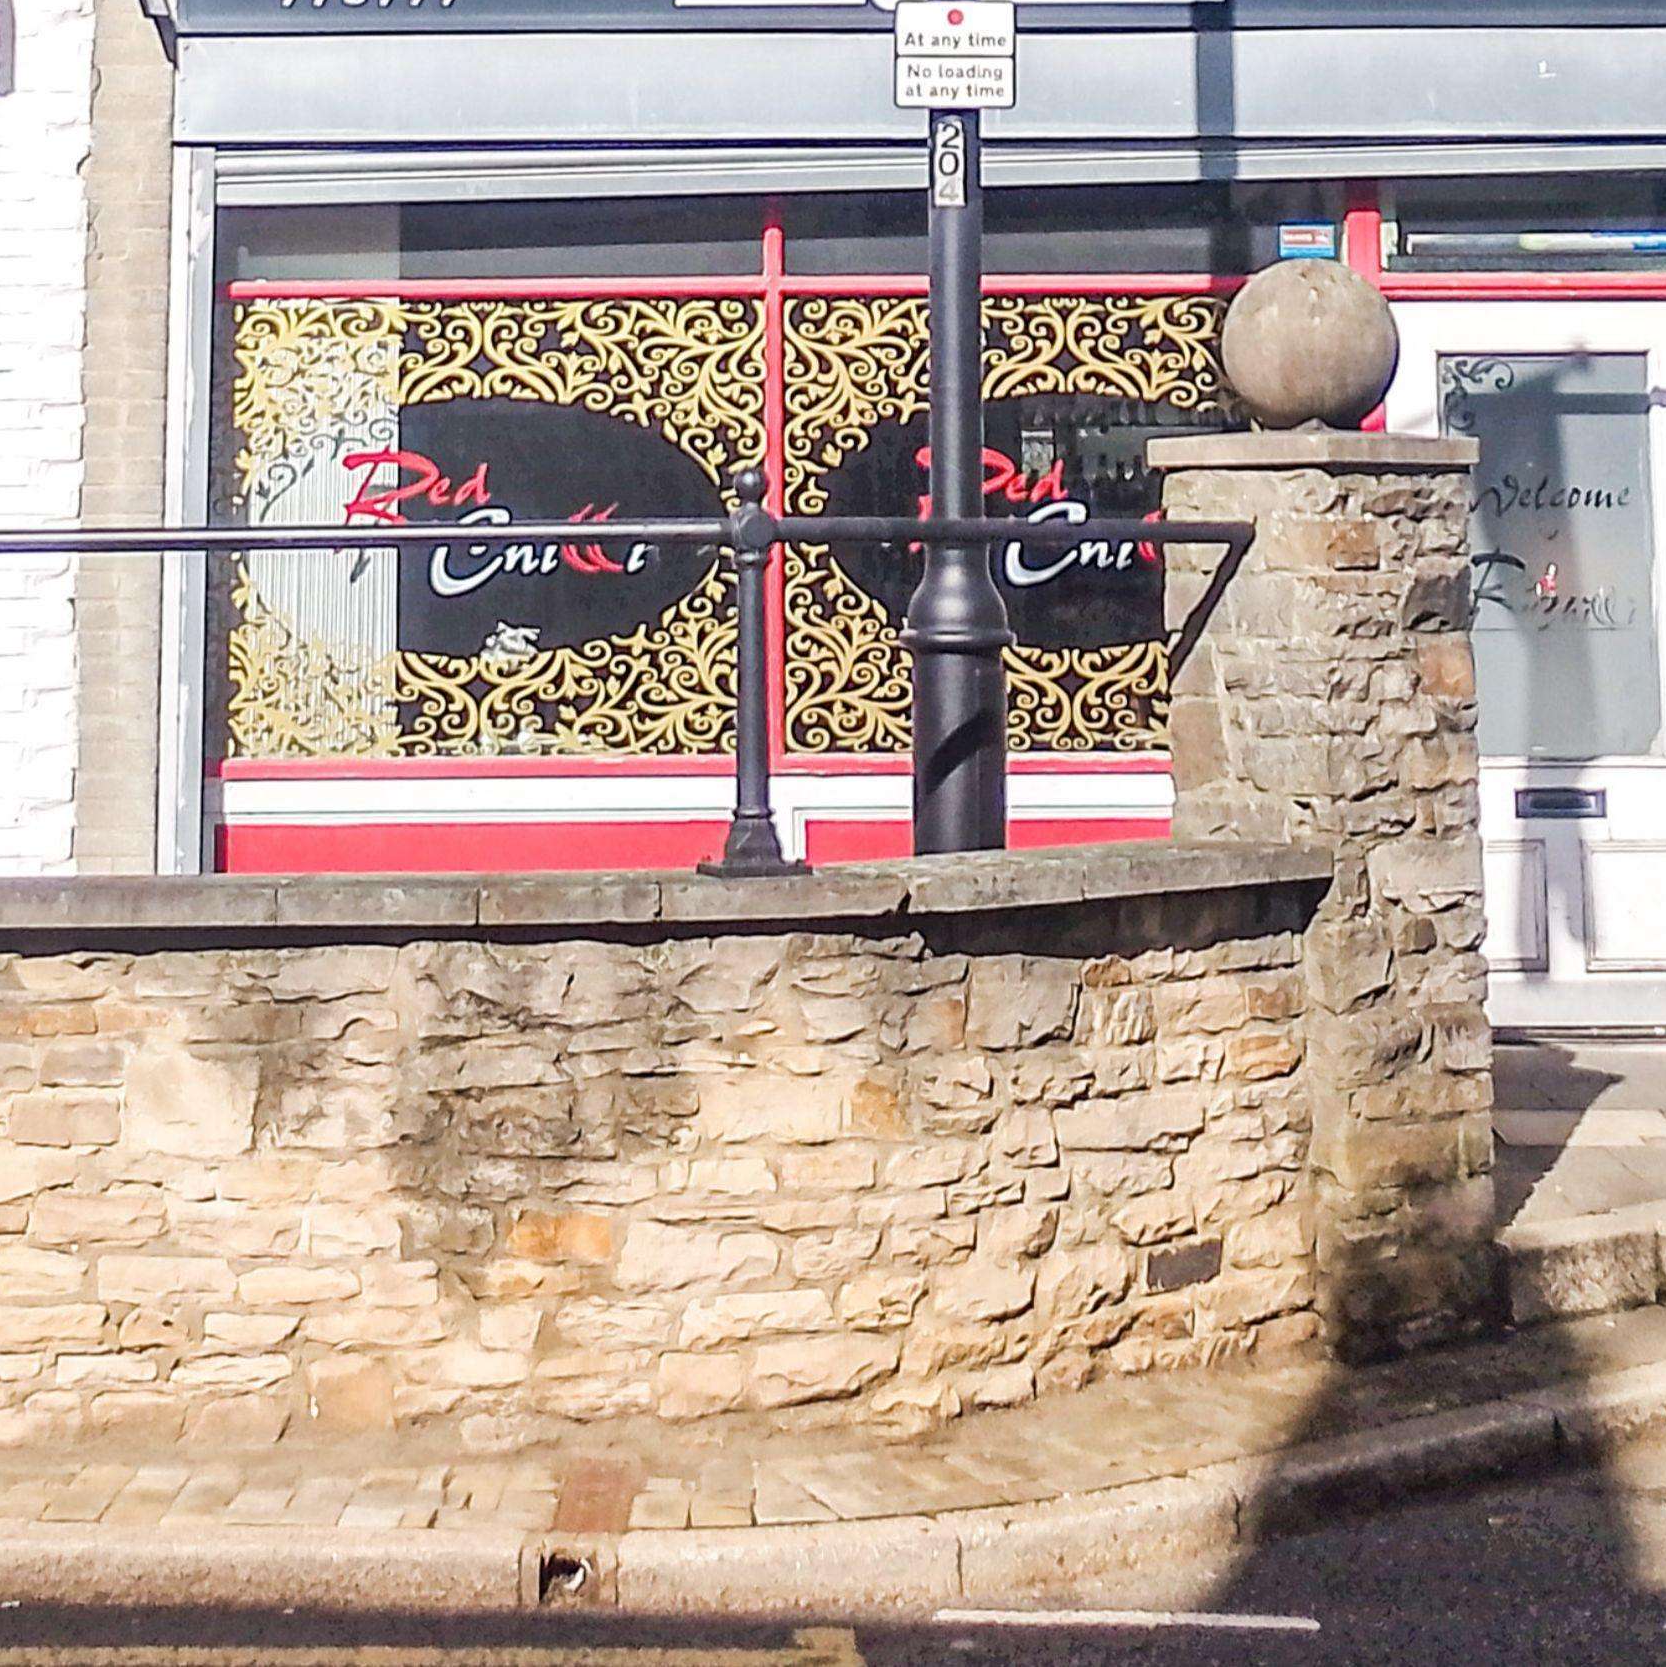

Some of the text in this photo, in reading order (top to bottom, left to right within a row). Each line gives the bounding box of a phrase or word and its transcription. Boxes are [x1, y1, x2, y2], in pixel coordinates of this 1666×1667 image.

[904, 33, 1007, 50] At any time
[907, 64, 1003, 81] No loading
[905, 84, 1005, 100] at any time
[1469, 474, 1632, 519] Welcome
